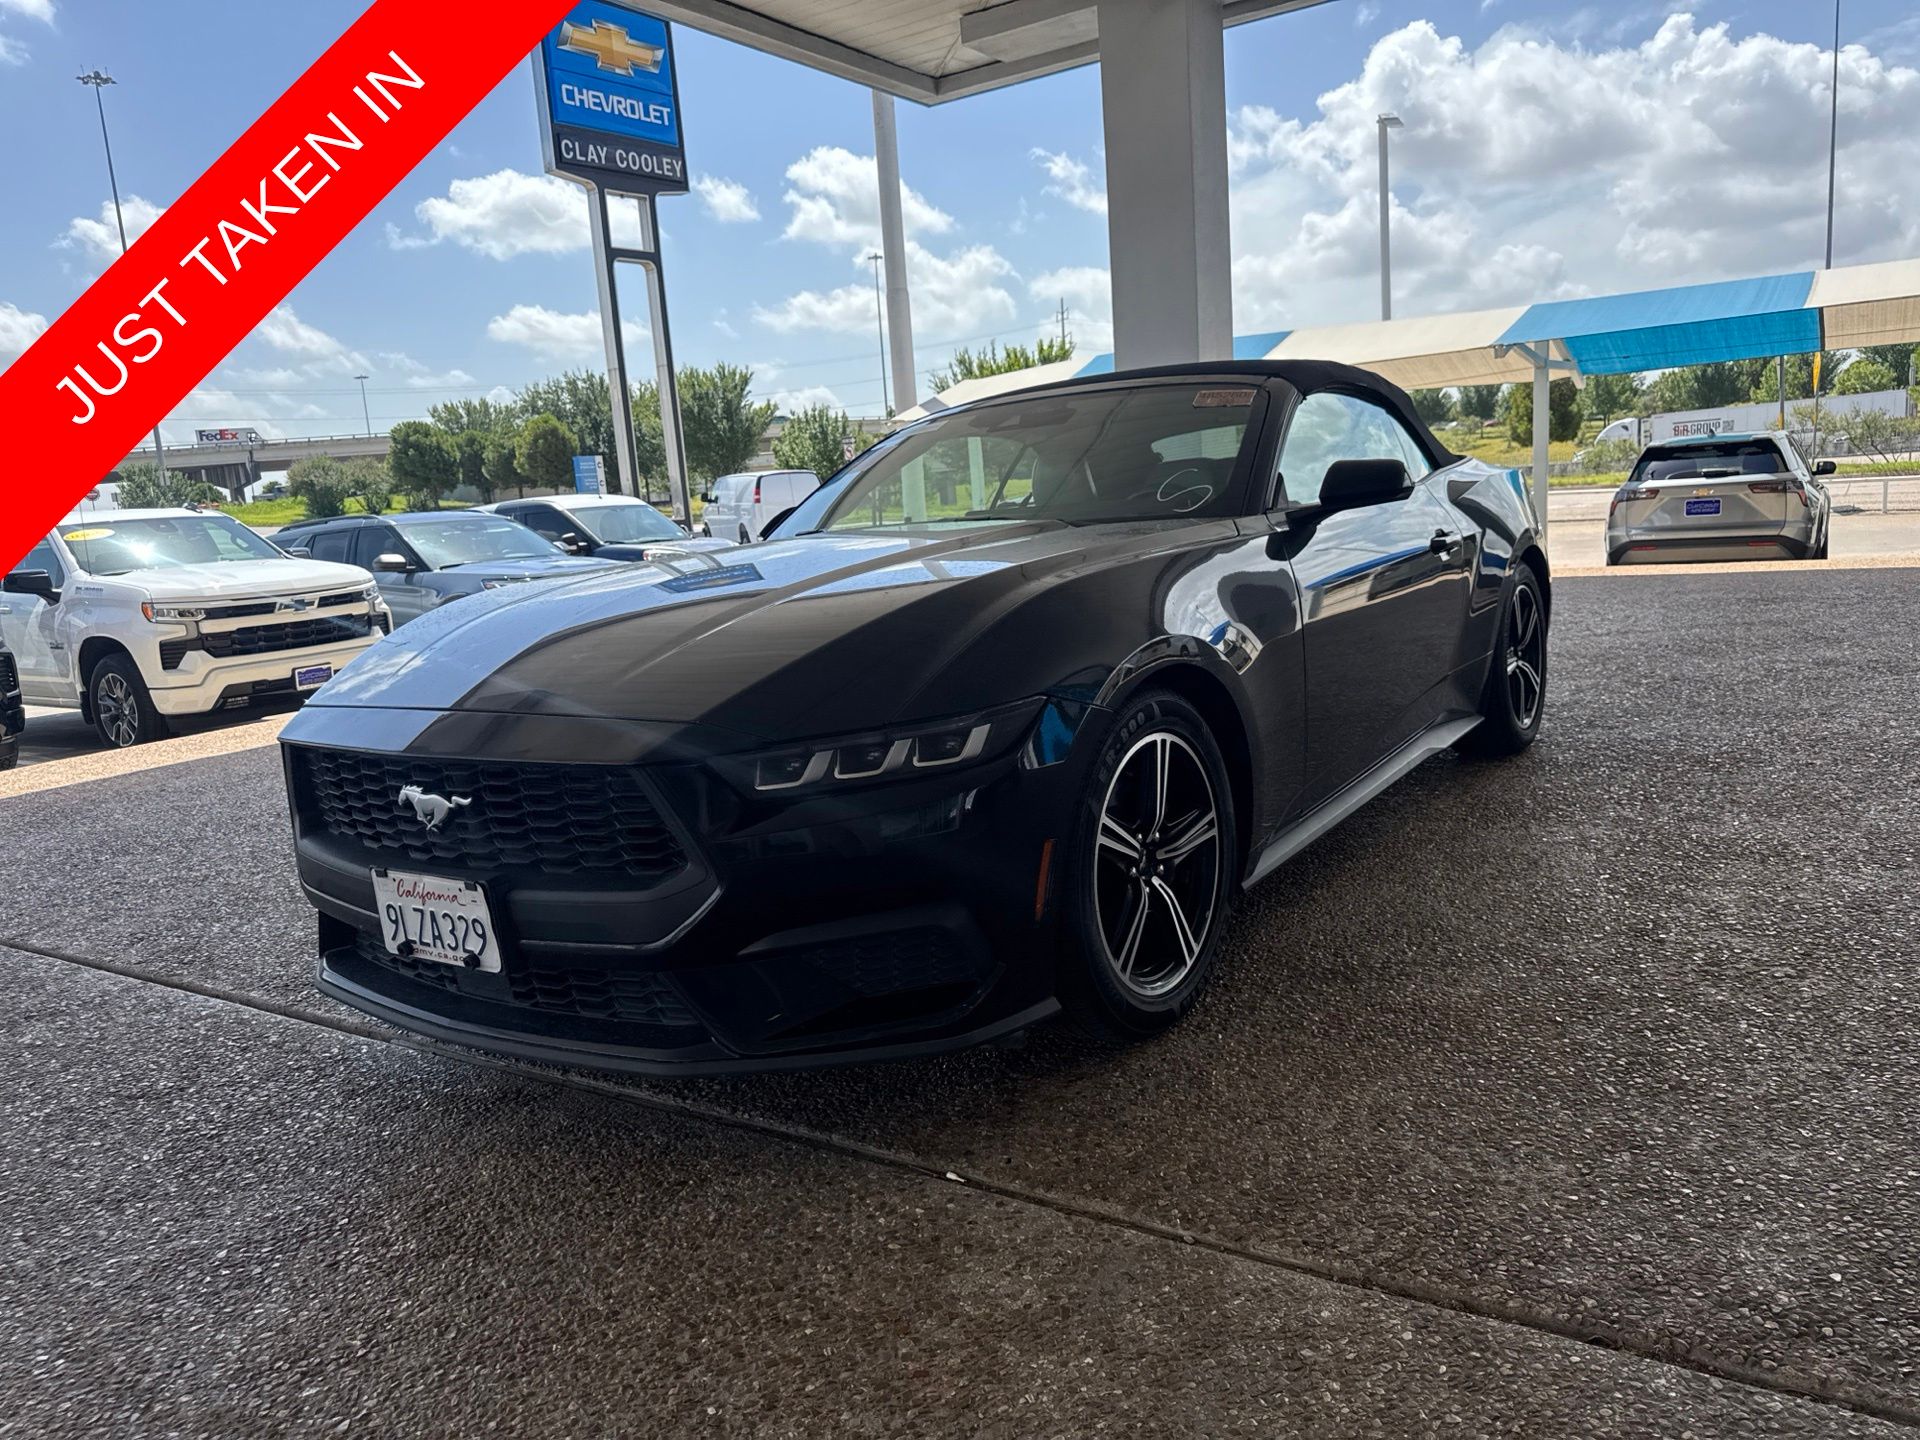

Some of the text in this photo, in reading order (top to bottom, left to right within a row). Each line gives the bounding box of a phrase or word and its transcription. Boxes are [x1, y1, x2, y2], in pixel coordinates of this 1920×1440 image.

[561, 83, 671, 126] CHEVROLET
[561, 139, 682, 178] CLAY COOLEY
[199, 429, 239, 441] FedEx
[397, 879, 467, 906] California
[385, 903, 487, 956] 9LZA329
